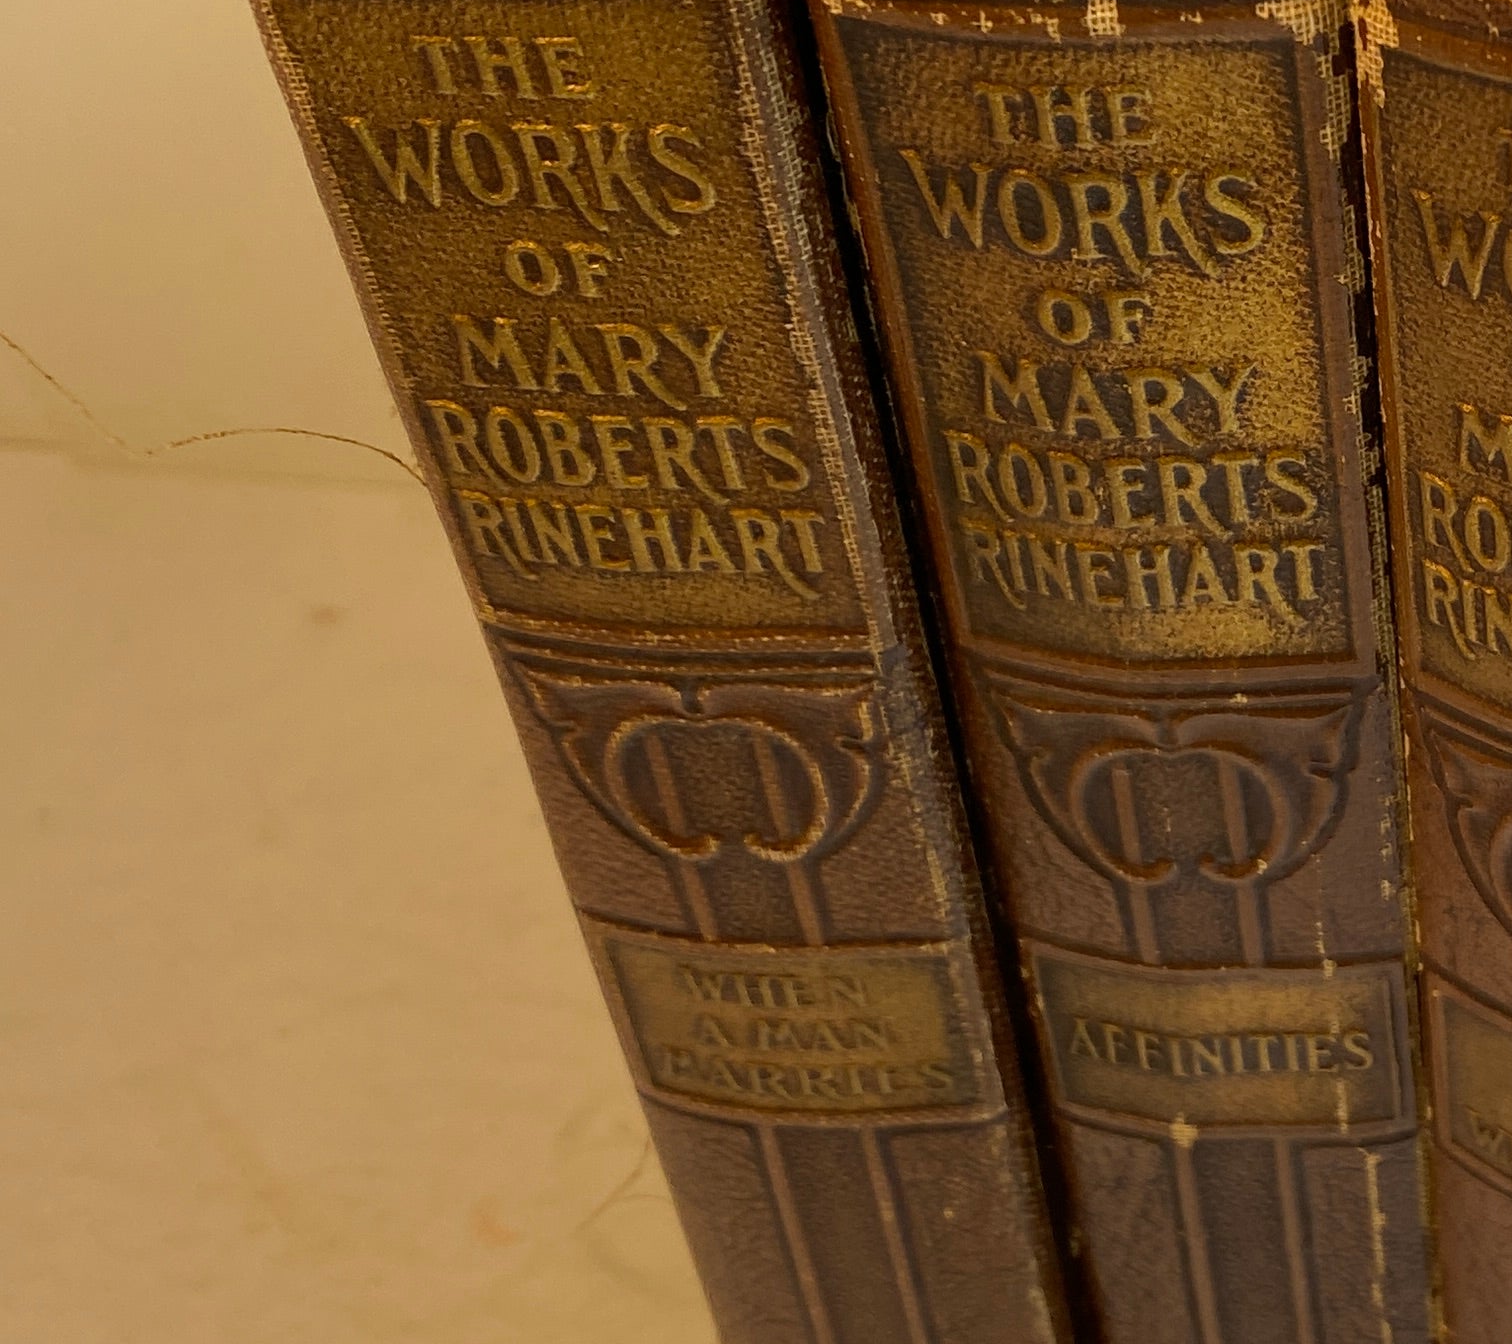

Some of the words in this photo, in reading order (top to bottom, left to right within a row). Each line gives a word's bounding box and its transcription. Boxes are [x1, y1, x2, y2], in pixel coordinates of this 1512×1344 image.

[409, 34, 596, 100] THE
[973, 81, 1158, 152] THE
[341, 115, 718, 236] WORKS
[900, 149, 1265, 280] WORKS
[505, 239, 622, 297] OF
[453, 313, 730, 410] MARY
[1036, 288, 1153, 346] OF
[980, 350, 1256, 447] MARY
[424, 398, 811, 504] ROBERTS
[942, 428, 1318, 541] ROBERTS
[457, 488, 827, 601] RINEHART
[960, 515, 1327, 626] RINEHART
[697, 1012, 731, 1050] A
[752, 1016, 892, 1053] MAN
[1070, 1017, 1375, 1078] AFFINITIES
